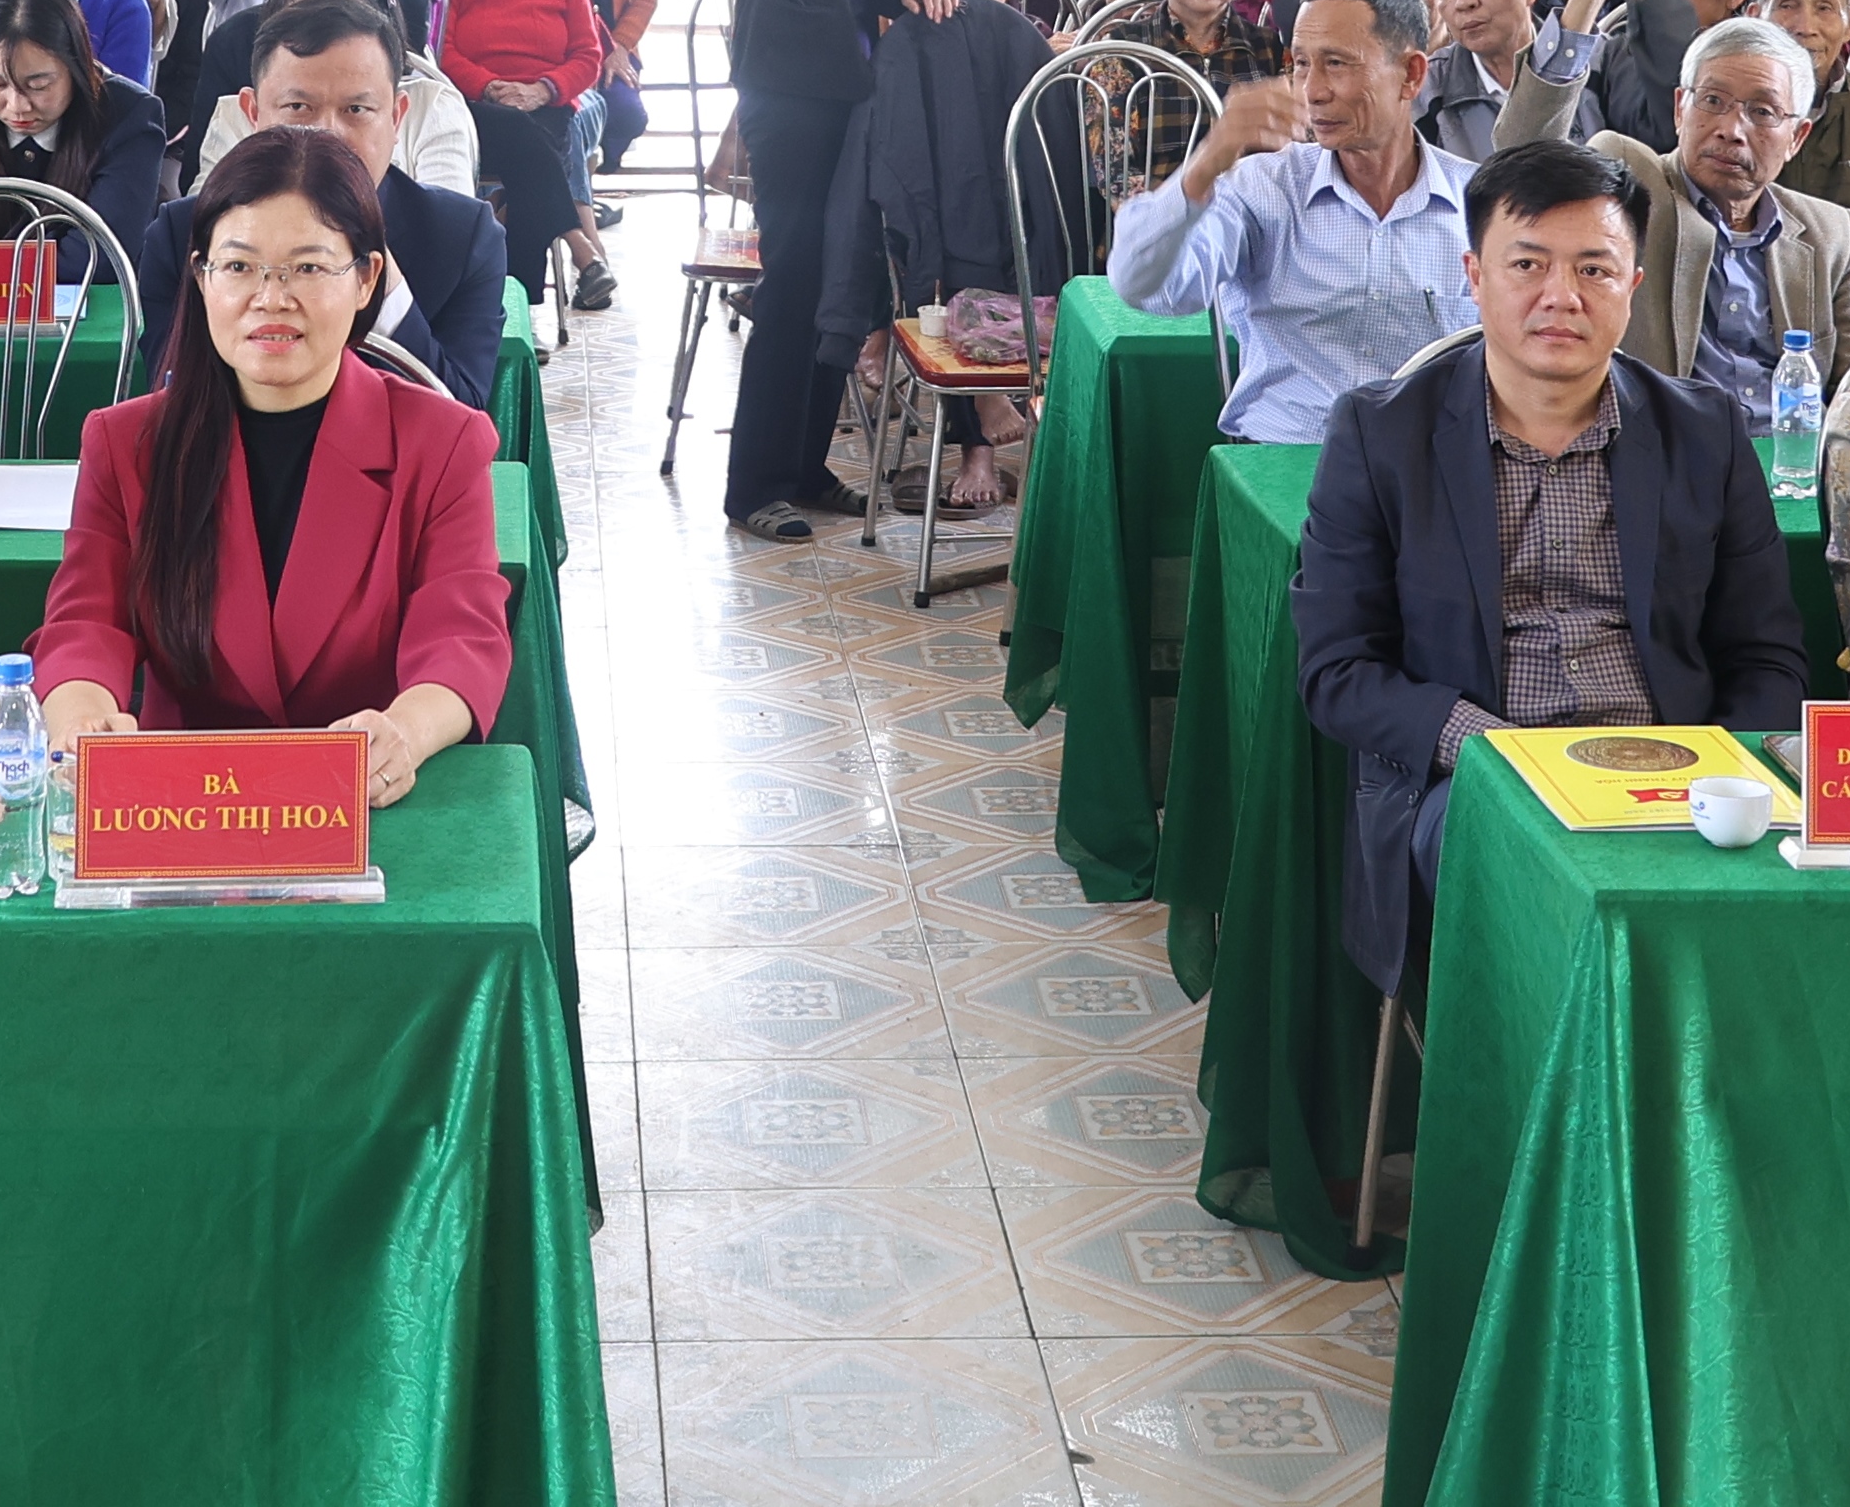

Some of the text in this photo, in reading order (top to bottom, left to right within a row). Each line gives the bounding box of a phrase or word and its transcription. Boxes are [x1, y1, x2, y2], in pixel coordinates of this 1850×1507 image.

[203, 767, 241, 796] BÀ
[92, 804, 350, 836] LƯƠNG THỊ HOA
